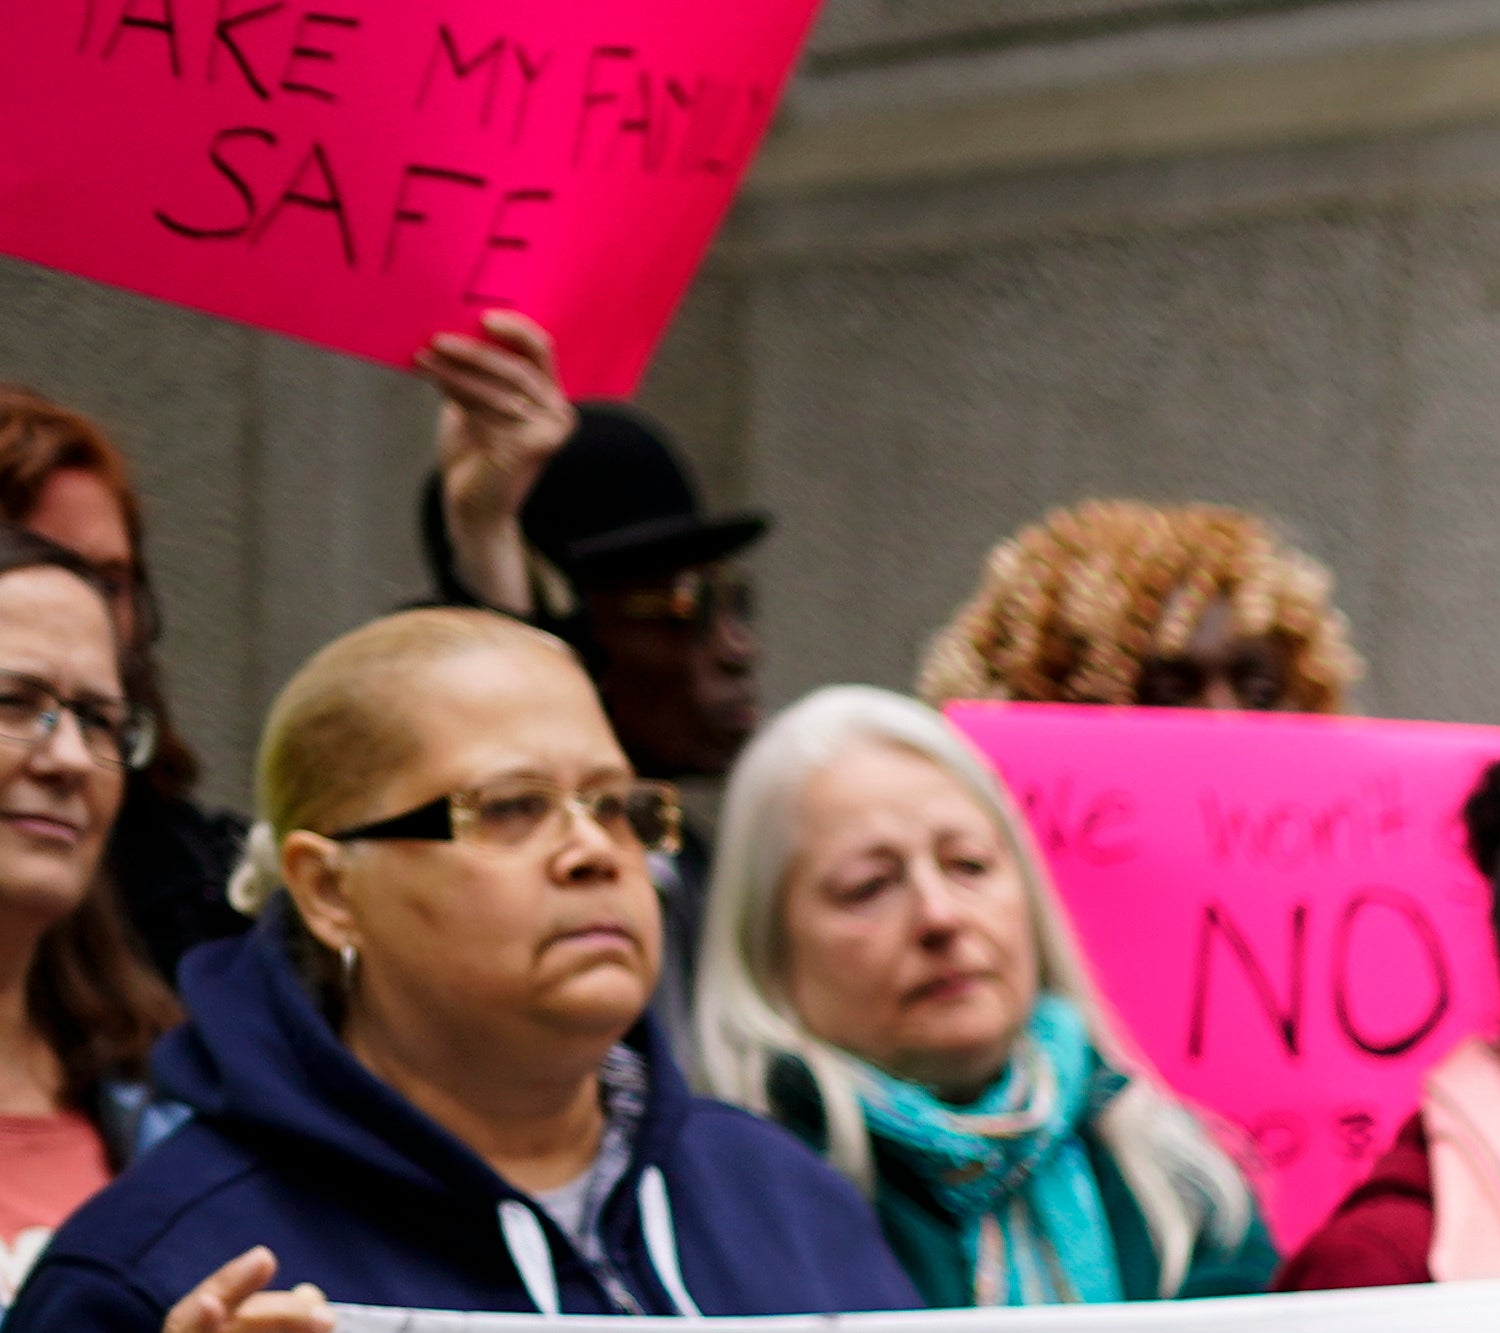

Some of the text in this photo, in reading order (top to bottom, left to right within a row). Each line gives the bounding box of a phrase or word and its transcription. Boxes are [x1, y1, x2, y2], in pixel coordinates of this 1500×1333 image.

[77, 0, 360, 102] AKE
[414, 22, 550, 146] MY
[154, 126, 555, 308] SAFE
[1185, 889, 1450, 1059] NO
